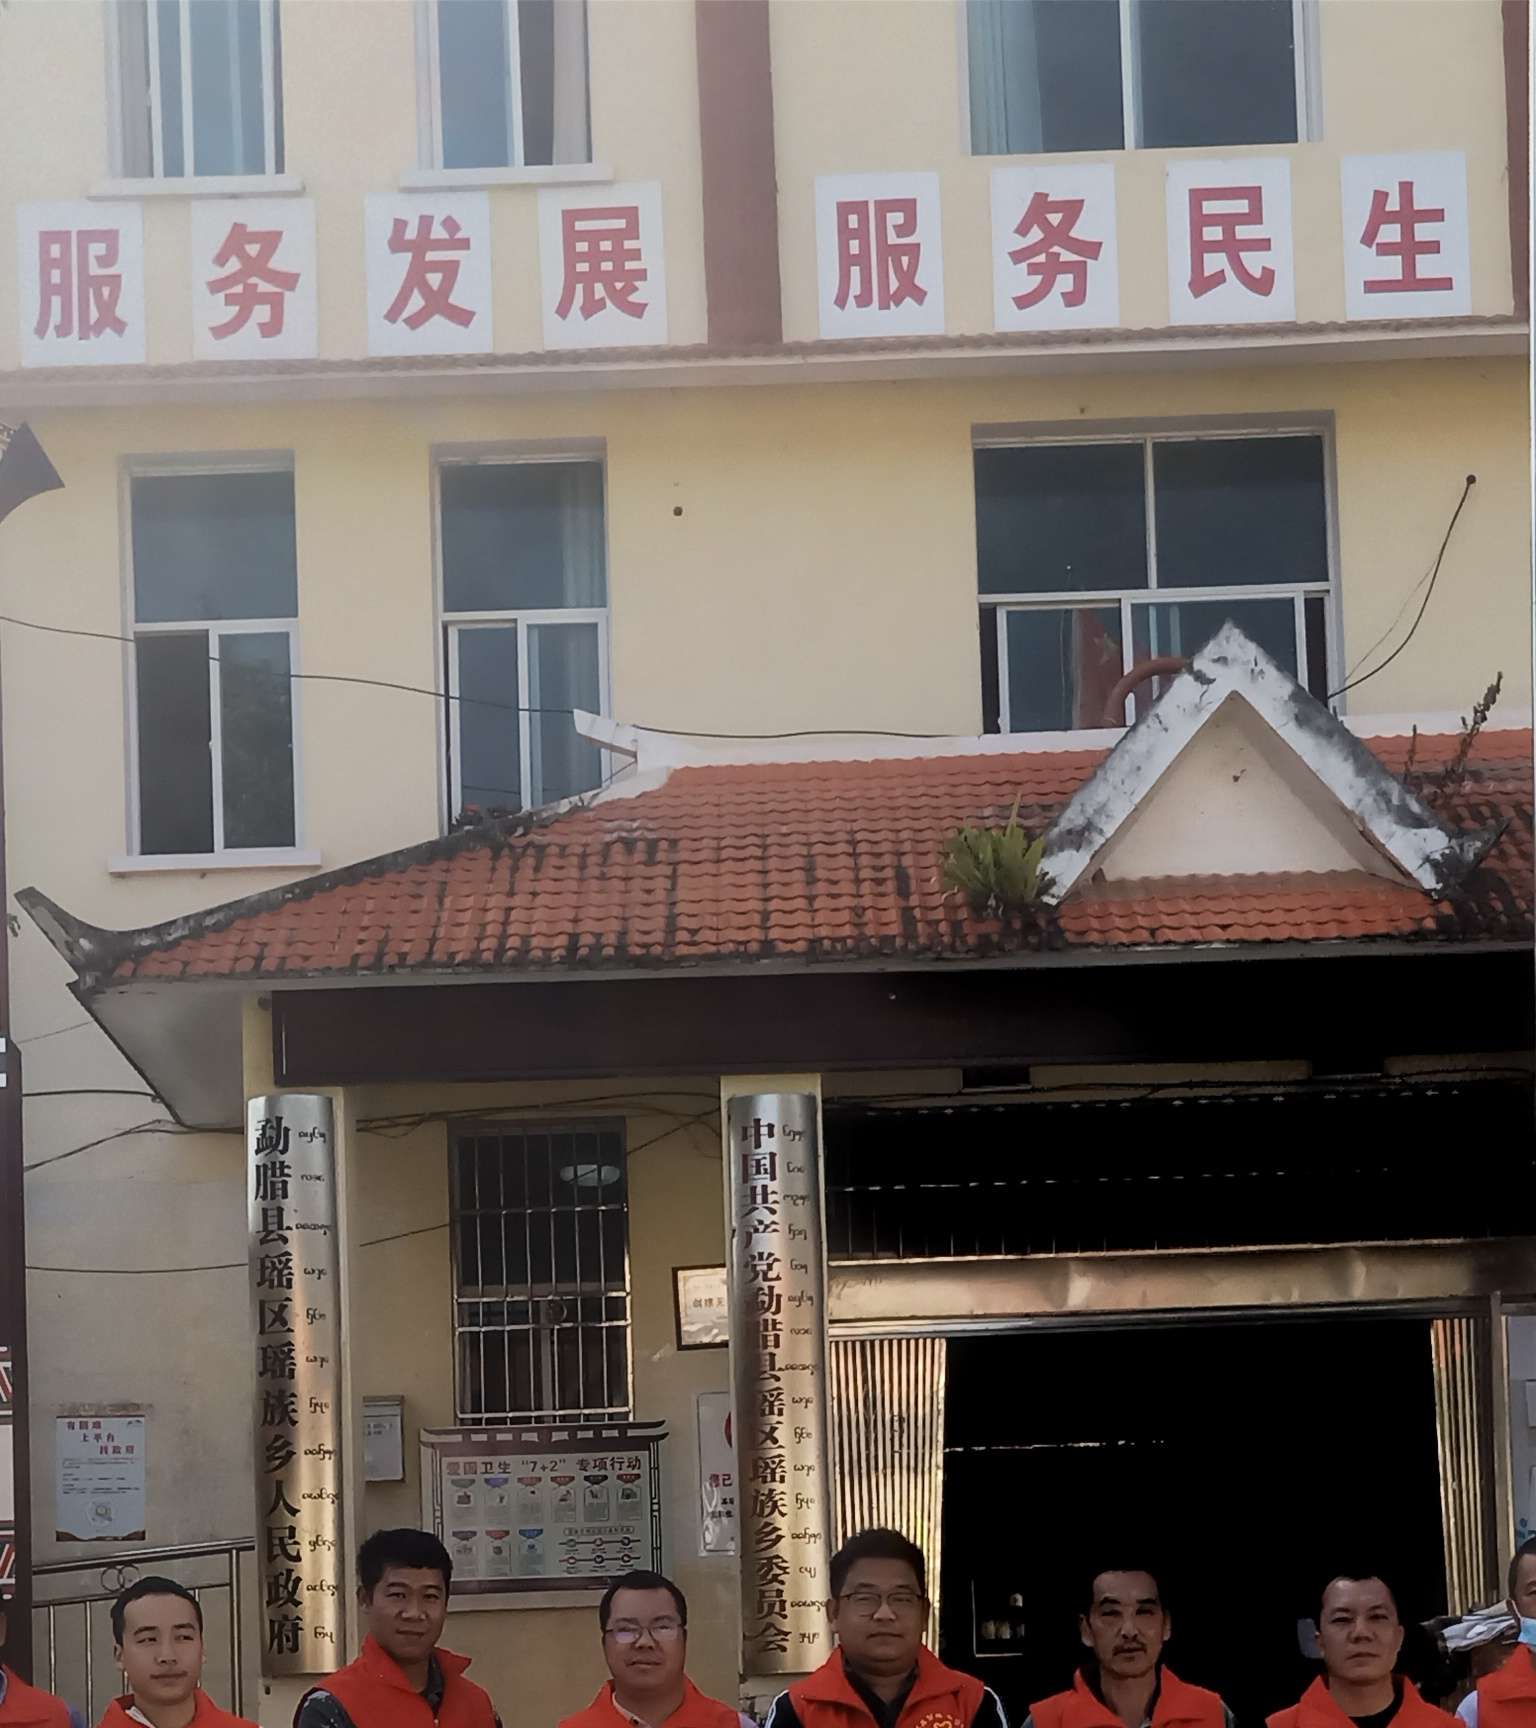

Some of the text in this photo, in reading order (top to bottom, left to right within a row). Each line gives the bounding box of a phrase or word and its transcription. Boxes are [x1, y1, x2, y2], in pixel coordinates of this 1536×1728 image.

[34, 201, 651, 343] 服务发展
[832, 180, 1456, 315] 服务民生
[254, 1115, 304, 1655] 勐腊县瑶区瑶族乡人民政府
[740, 1117, 792, 1653] 中国共产党勐腊县瑶区瑶族乡委员会
